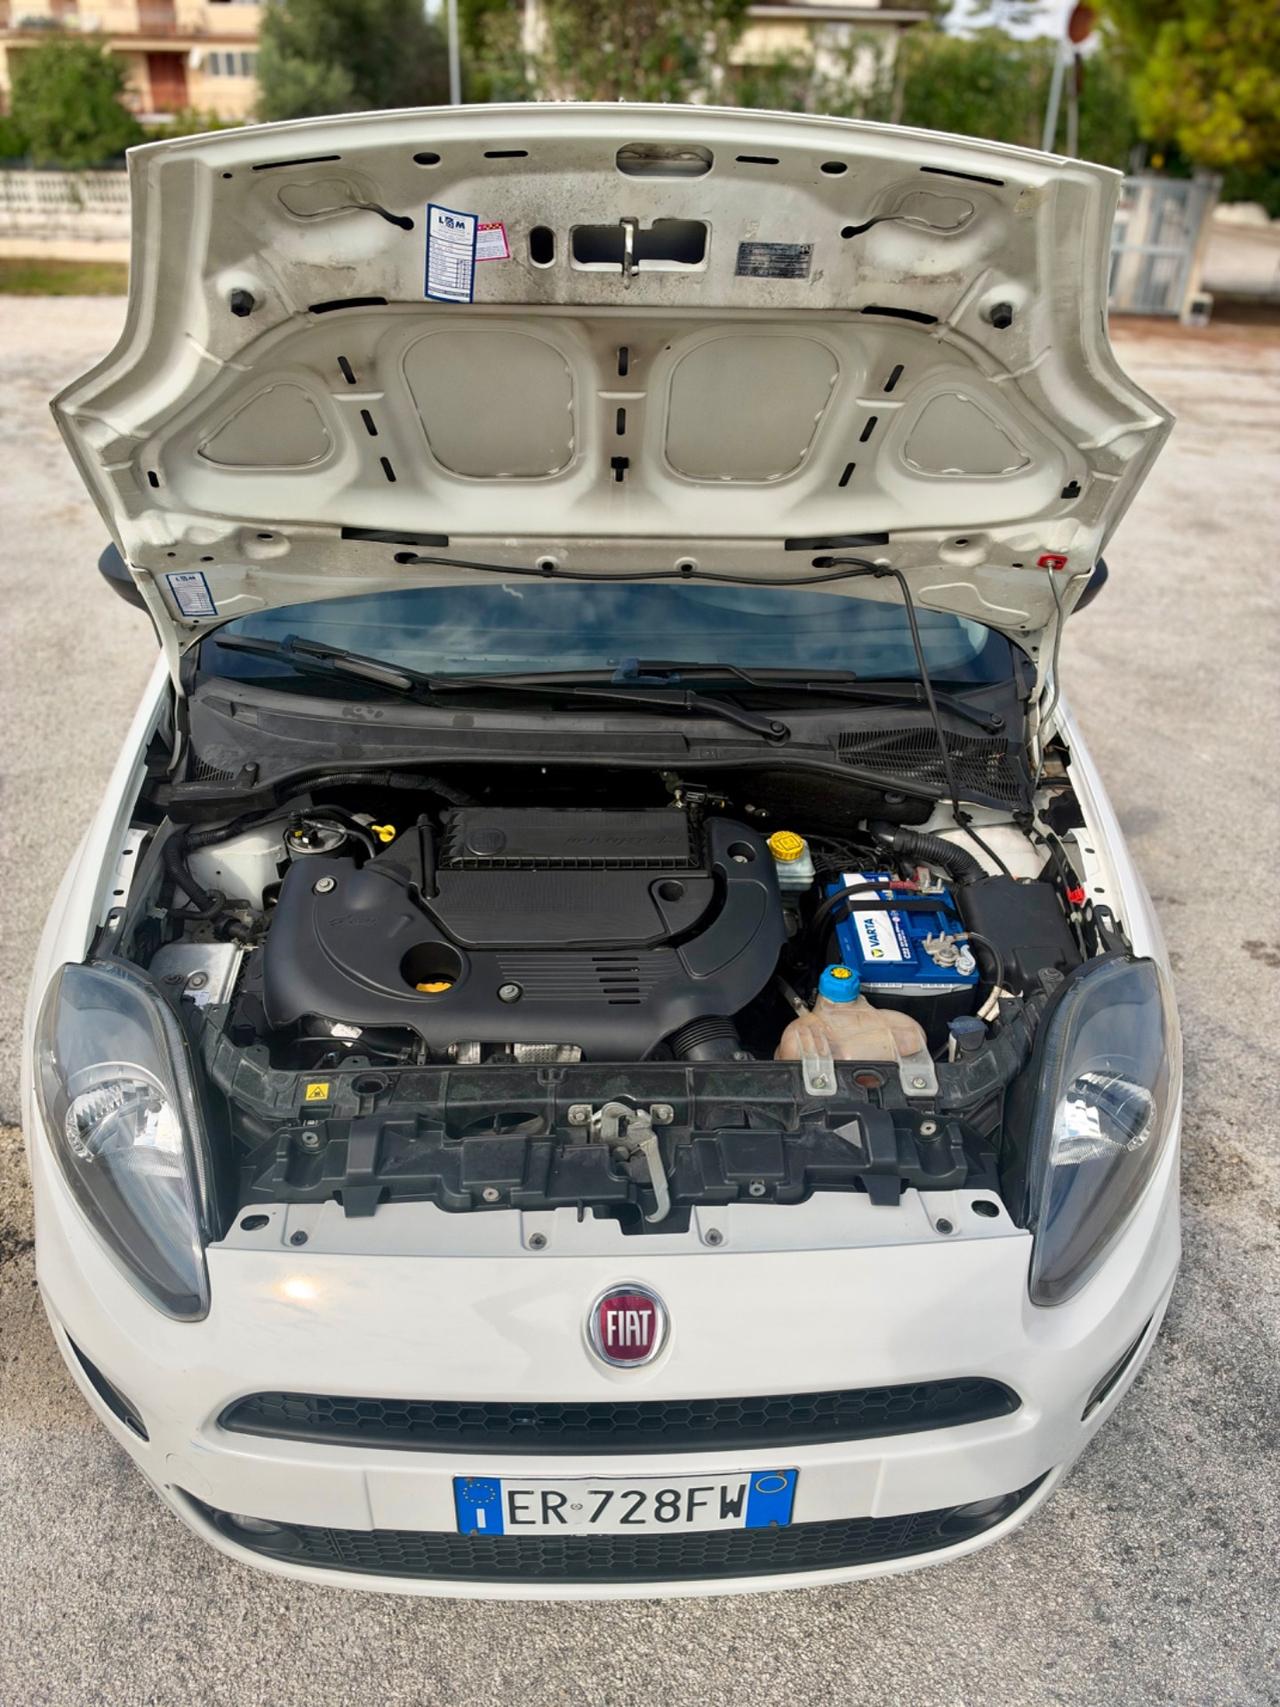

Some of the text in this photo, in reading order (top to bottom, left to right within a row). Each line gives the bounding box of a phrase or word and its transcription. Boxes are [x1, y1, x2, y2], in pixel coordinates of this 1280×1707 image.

[863, 918, 881, 947] VARTA
[607, 1310, 652, 1346] FIAT
[507, 1484, 746, 1524] ER 728FW
